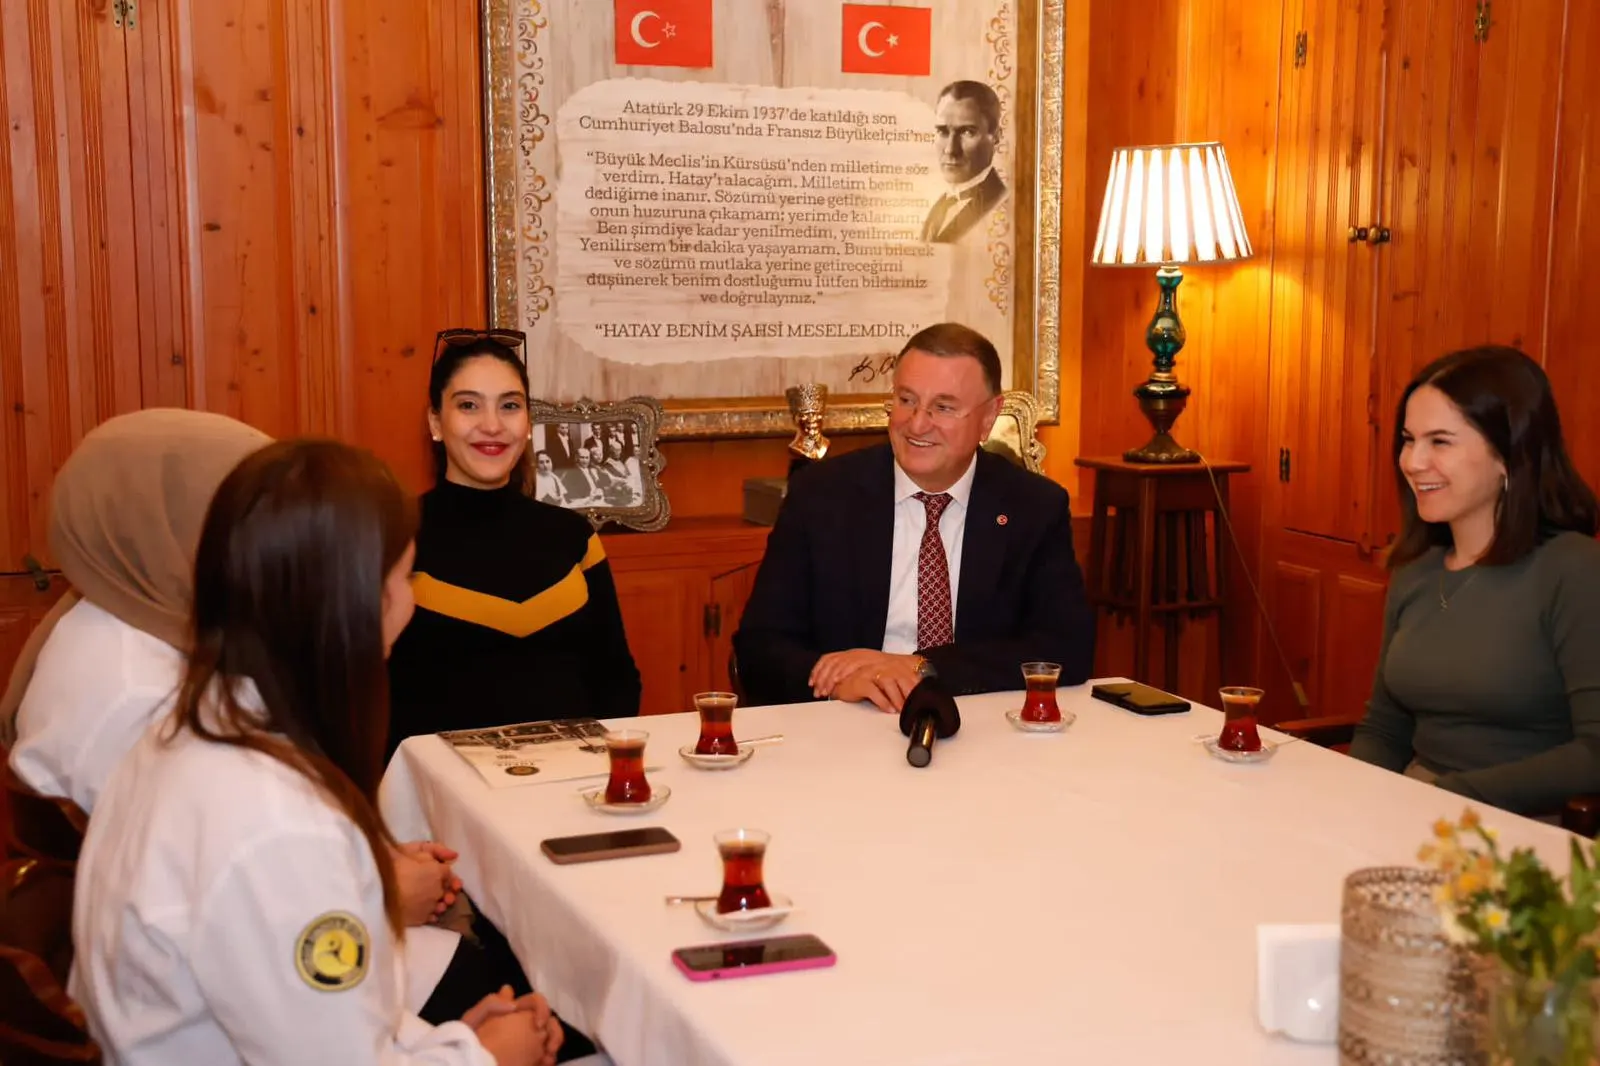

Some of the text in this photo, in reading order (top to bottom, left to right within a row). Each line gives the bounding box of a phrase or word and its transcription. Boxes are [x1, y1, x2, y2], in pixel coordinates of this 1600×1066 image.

[622, 100, 683, 116] Atatürk
[687, 103, 704, 117] 29
[707, 104, 749, 119] Ekim
[810, 109, 869, 127] katıldığı
[872, 113, 897, 125] son
[579, 115, 674, 136] Cumhuriyet
[679, 119, 762, 137] Balosu'nda
[767, 123, 822, 139] Fransız
[830, 160, 905, 175] milletime
[905, 163, 929, 175] söz
[603, 170, 665, 185] verdim.
[724, 174, 798, 191] alacağım.
[801, 175, 866, 191] Milletim
[869, 178, 914, 192] benim
[585, 186, 658, 203] dediğime
[662, 188, 711, 203] inanır.
[714, 189, 775, 204] Sözümü
[779, 193, 826, 208] yerine
[590, 206, 630, 218] onun
[633, 204, 706, 220] huzuruna
[788, 209, 849, 224] yerimde
[597, 220, 628, 235] Ben
[631, 221, 693, 239] şimdiye
[696, 223, 740, 237] kadar
[580, 237, 666, 252] Yenilirsem
[669, 239, 692, 253] bir
[694, 239, 745, 254] dakika
[845, 242, 884, 256] Bunu
[614, 257, 903, 275] ve sözümü mutlaka yerine getireceğimi
[586, 272, 928, 290] düşünerek benim dostluğumu lütfen bildiriniz
[700, 293, 718, 304] ve
[666, 320, 728, 338] BENİM
[731, 321, 784, 341] ŞAHSİ
